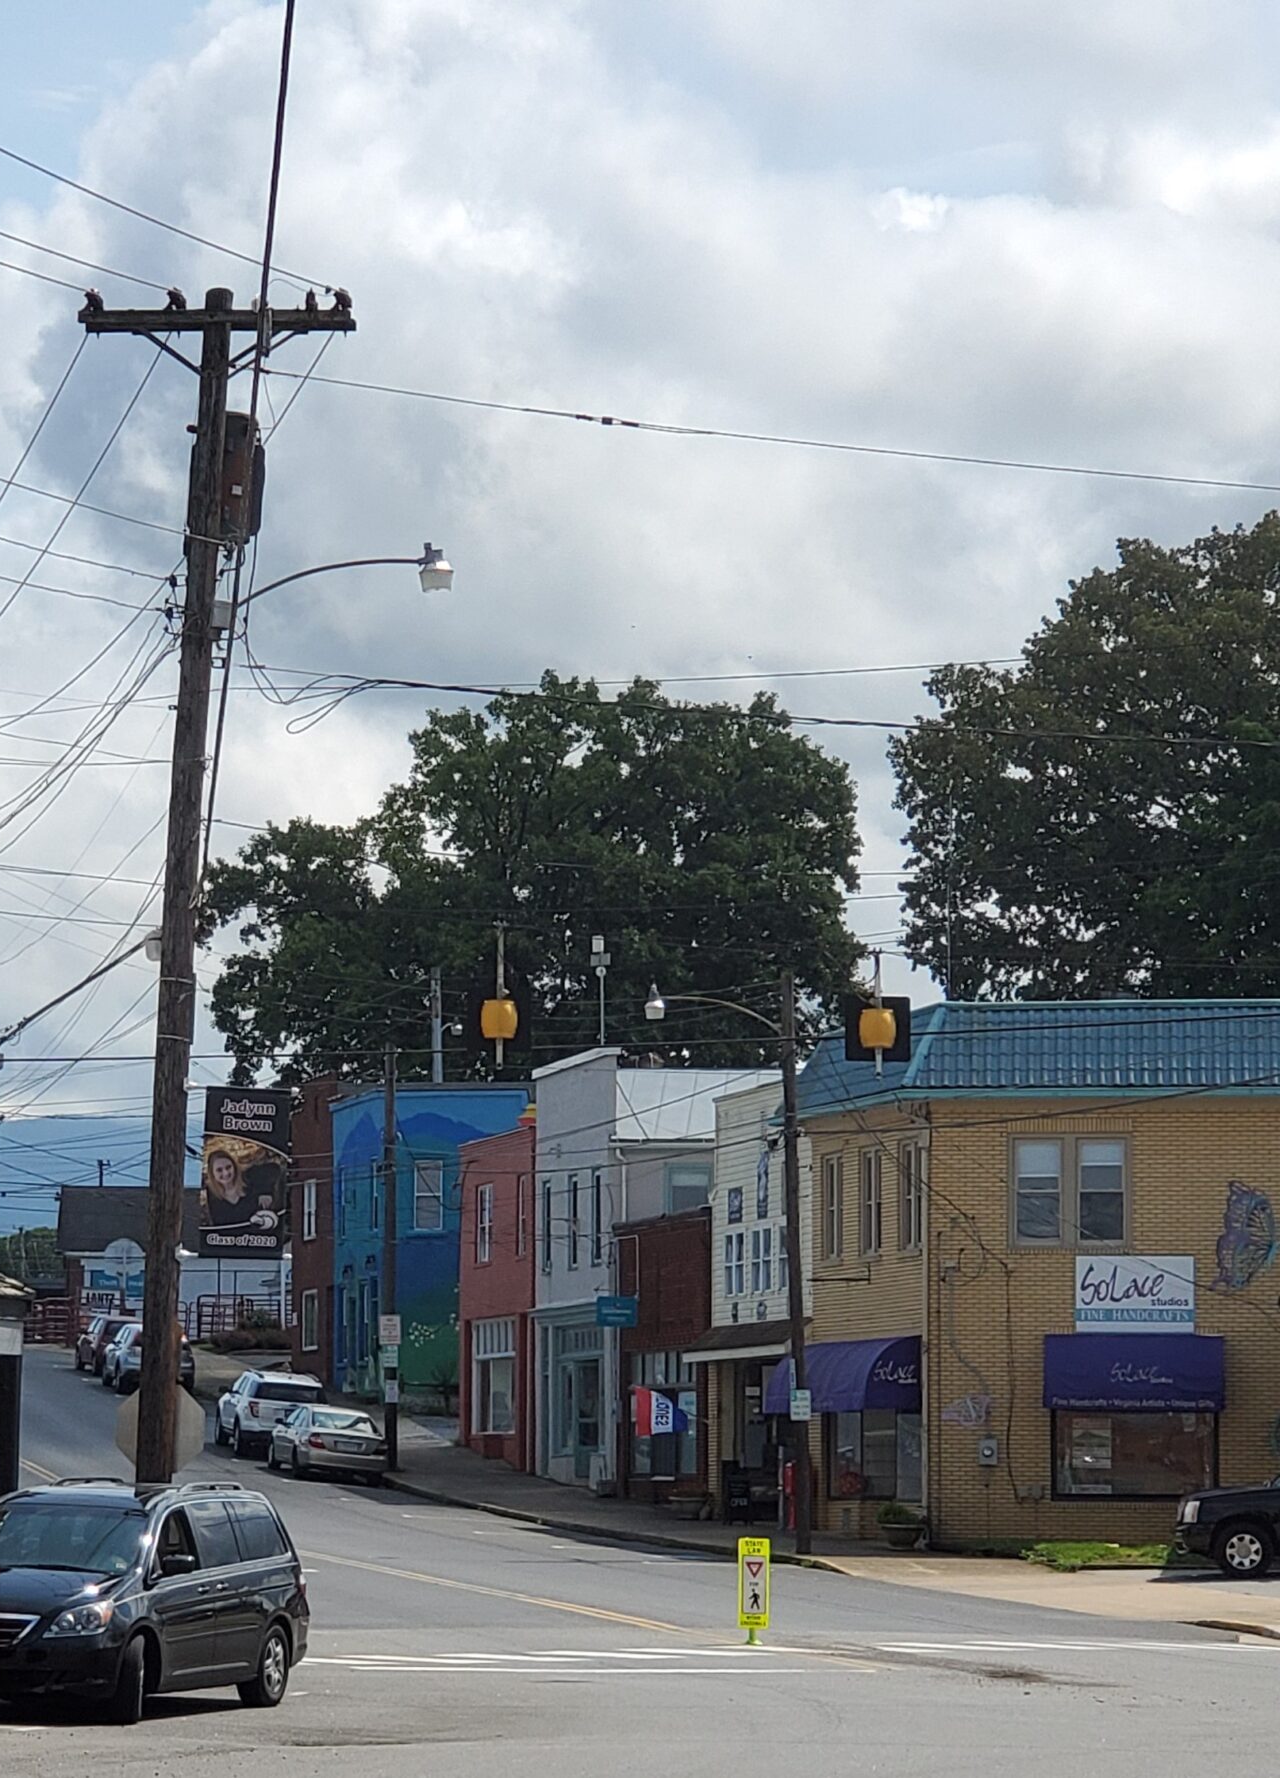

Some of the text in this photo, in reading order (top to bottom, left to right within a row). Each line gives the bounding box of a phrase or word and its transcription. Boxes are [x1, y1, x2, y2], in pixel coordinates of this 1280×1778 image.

[221, 1099, 276, 1117] Jadynn
[223, 1116, 272, 1131] Brown
[206, 1233, 276, 1247] Class of 2020
[1151, 1297, 1189, 1306] studios
[1081, 1310, 1189, 1321] FINE HANDCRAFTS
